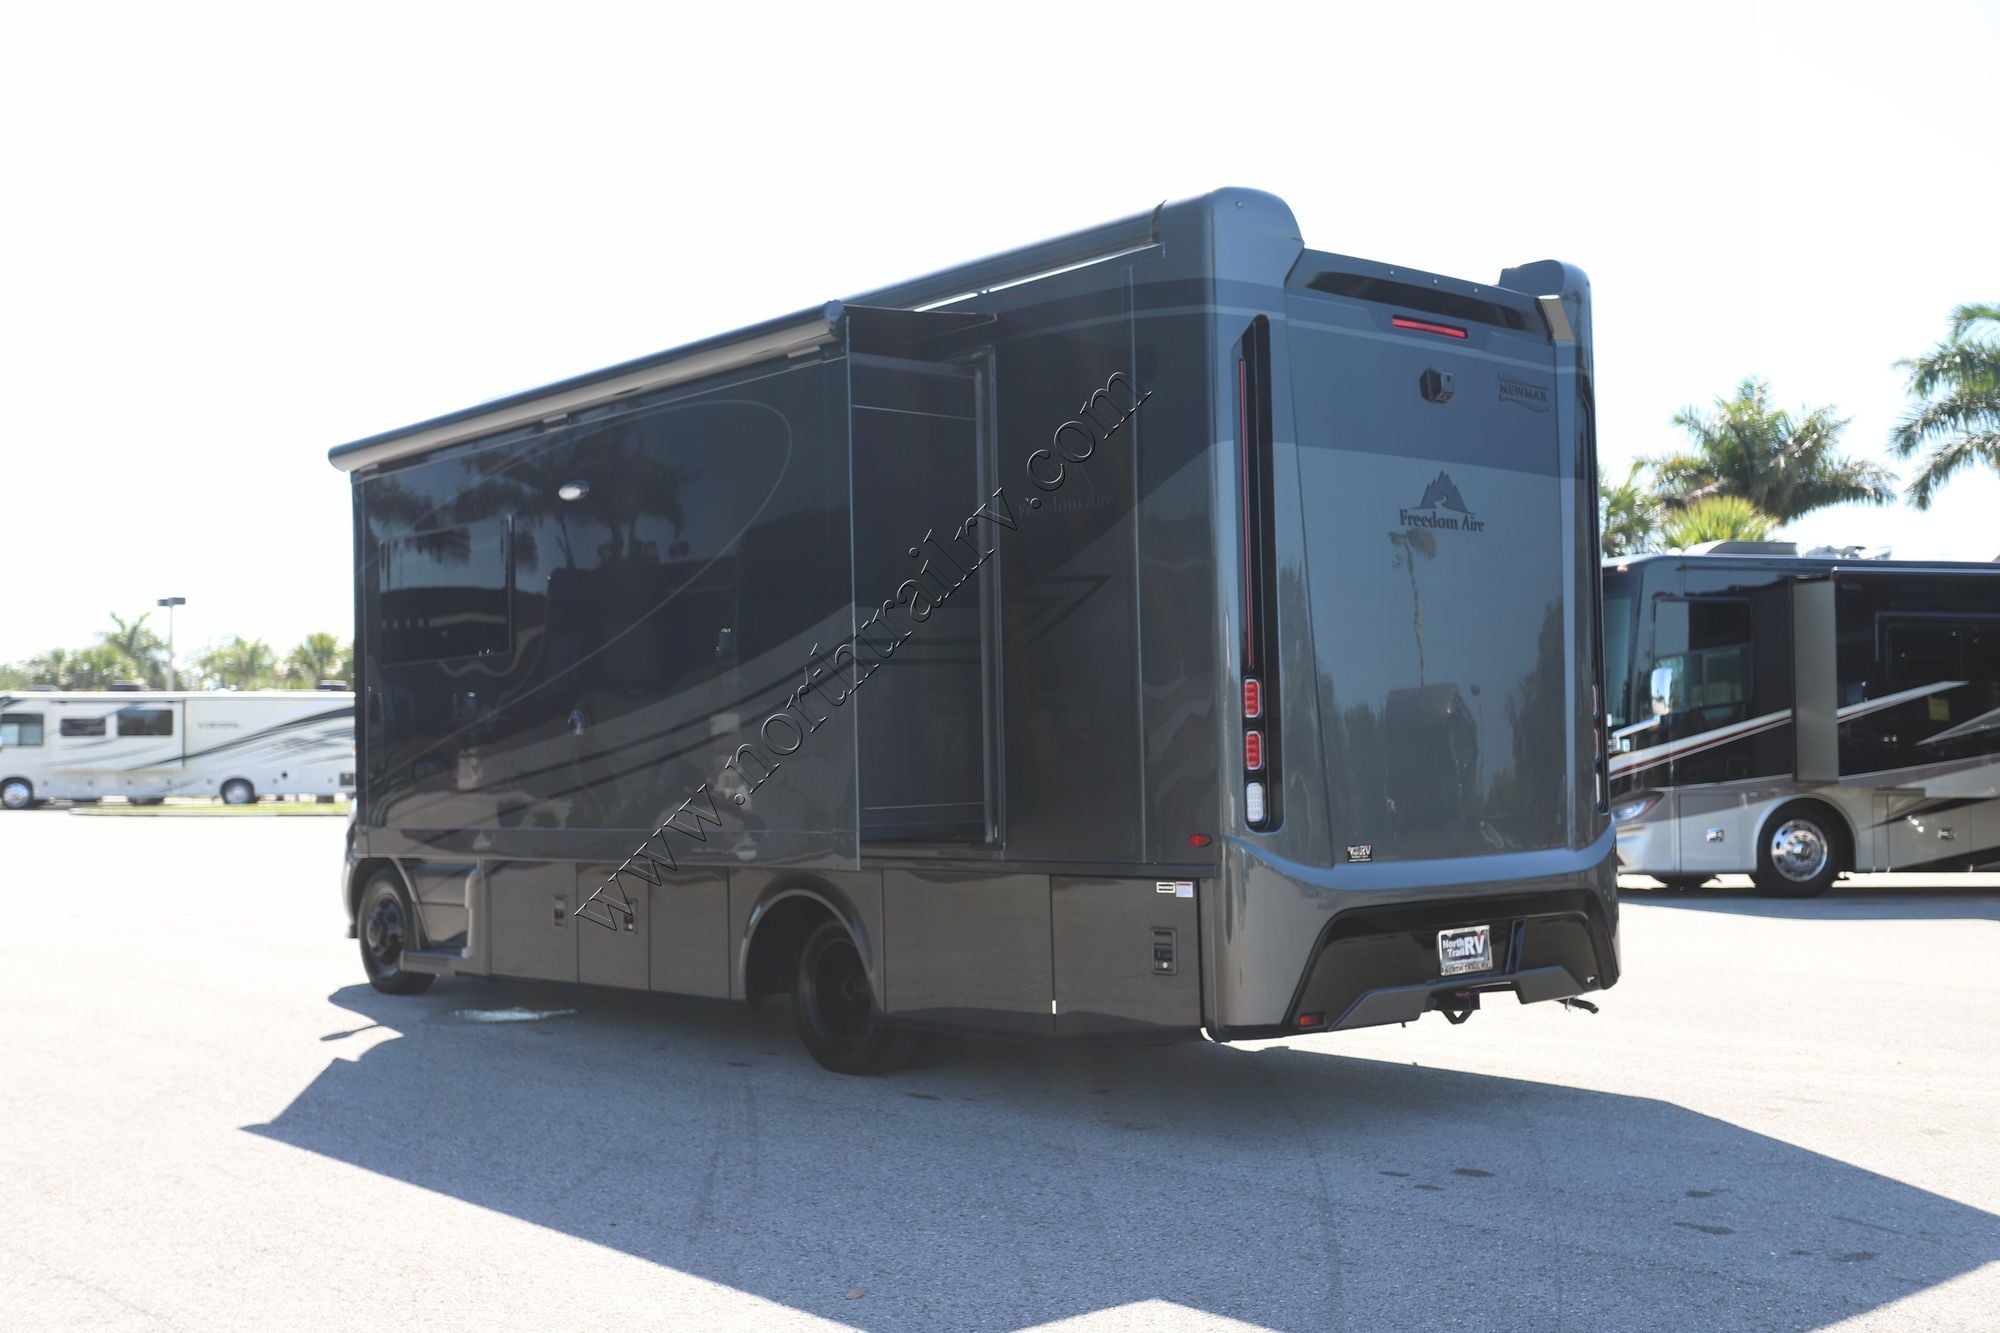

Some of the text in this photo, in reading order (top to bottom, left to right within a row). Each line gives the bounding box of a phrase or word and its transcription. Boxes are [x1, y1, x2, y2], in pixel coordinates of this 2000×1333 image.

[1499, 383, 1547, 401] NEWMAR
[1399, 508, 1485, 532] Freedom Aire
[1442, 933, 1485, 956] North RV
[1447, 947, 1465, 958] Trail
